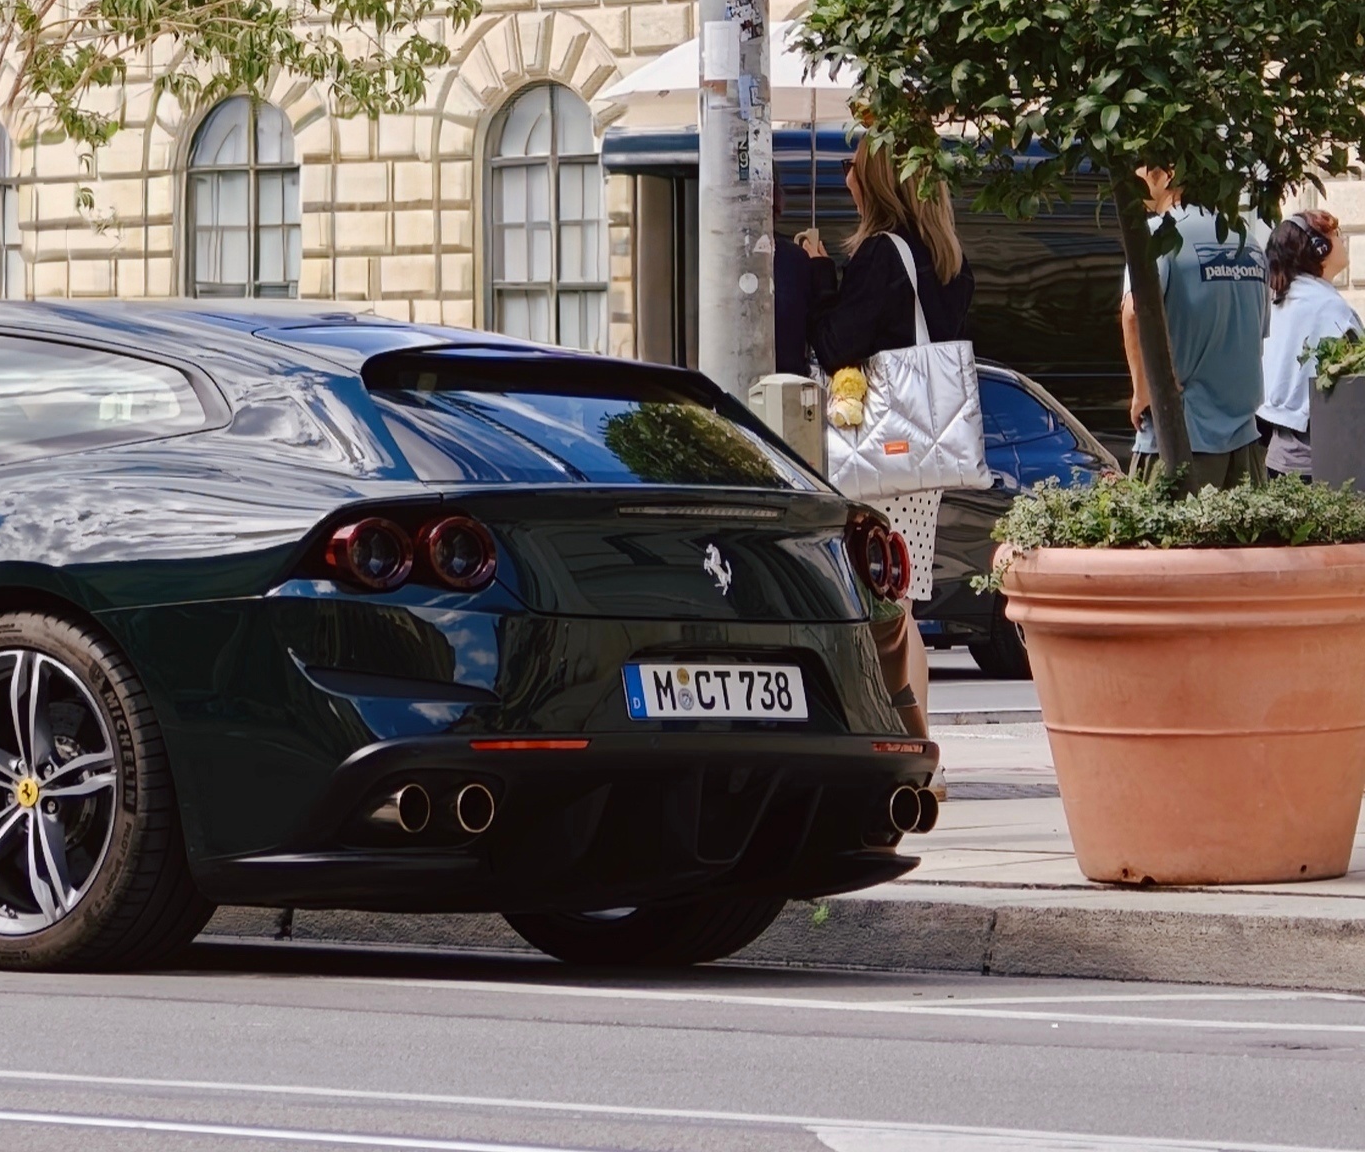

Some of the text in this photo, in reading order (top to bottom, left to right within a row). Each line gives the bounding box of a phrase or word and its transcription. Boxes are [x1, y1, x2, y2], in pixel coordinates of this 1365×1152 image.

[653, 671, 793, 712] M CT 738
[104, 690, 136, 806] MICHELIN
